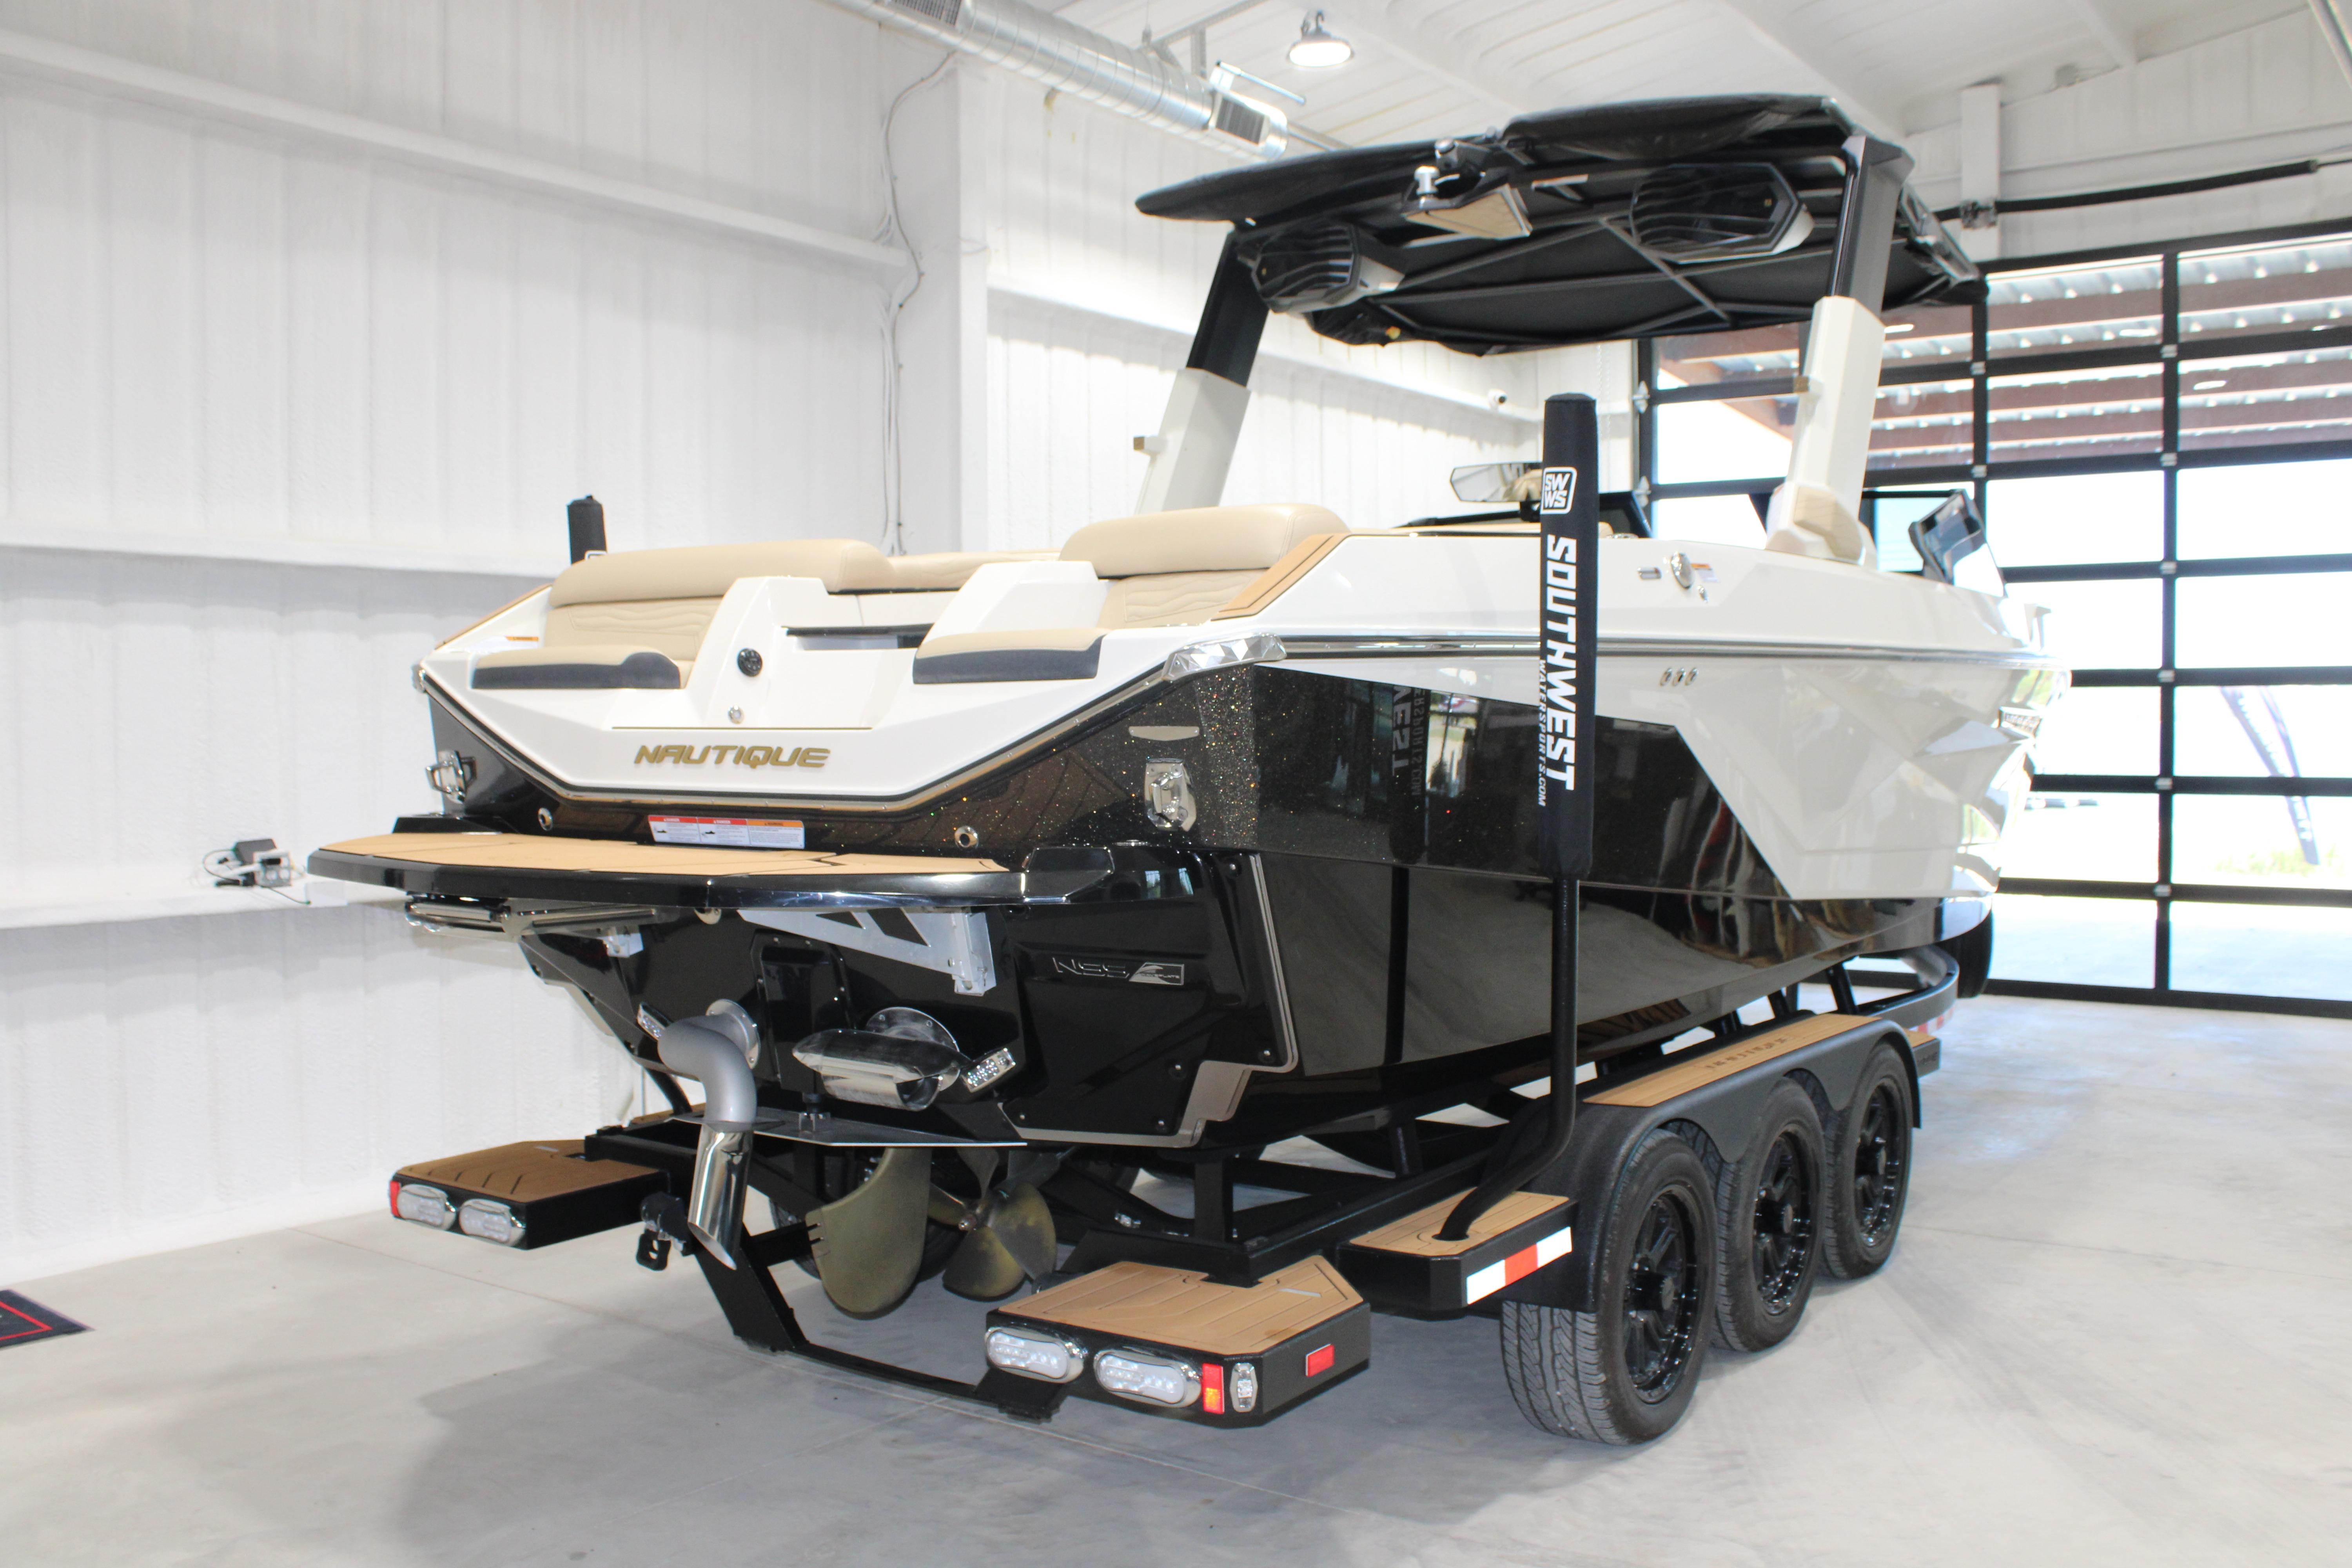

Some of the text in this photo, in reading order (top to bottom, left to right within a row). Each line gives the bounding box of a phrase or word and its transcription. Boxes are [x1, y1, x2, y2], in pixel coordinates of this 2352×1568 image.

[1545, 473, 1571, 491] SW
[1544, 490, 1568, 508] WS
[1546, 534, 1577, 790] SOUTHWEST
[634, 745, 831, 768] NAUTIQUE
[1052, 957, 1130, 979] NSS
